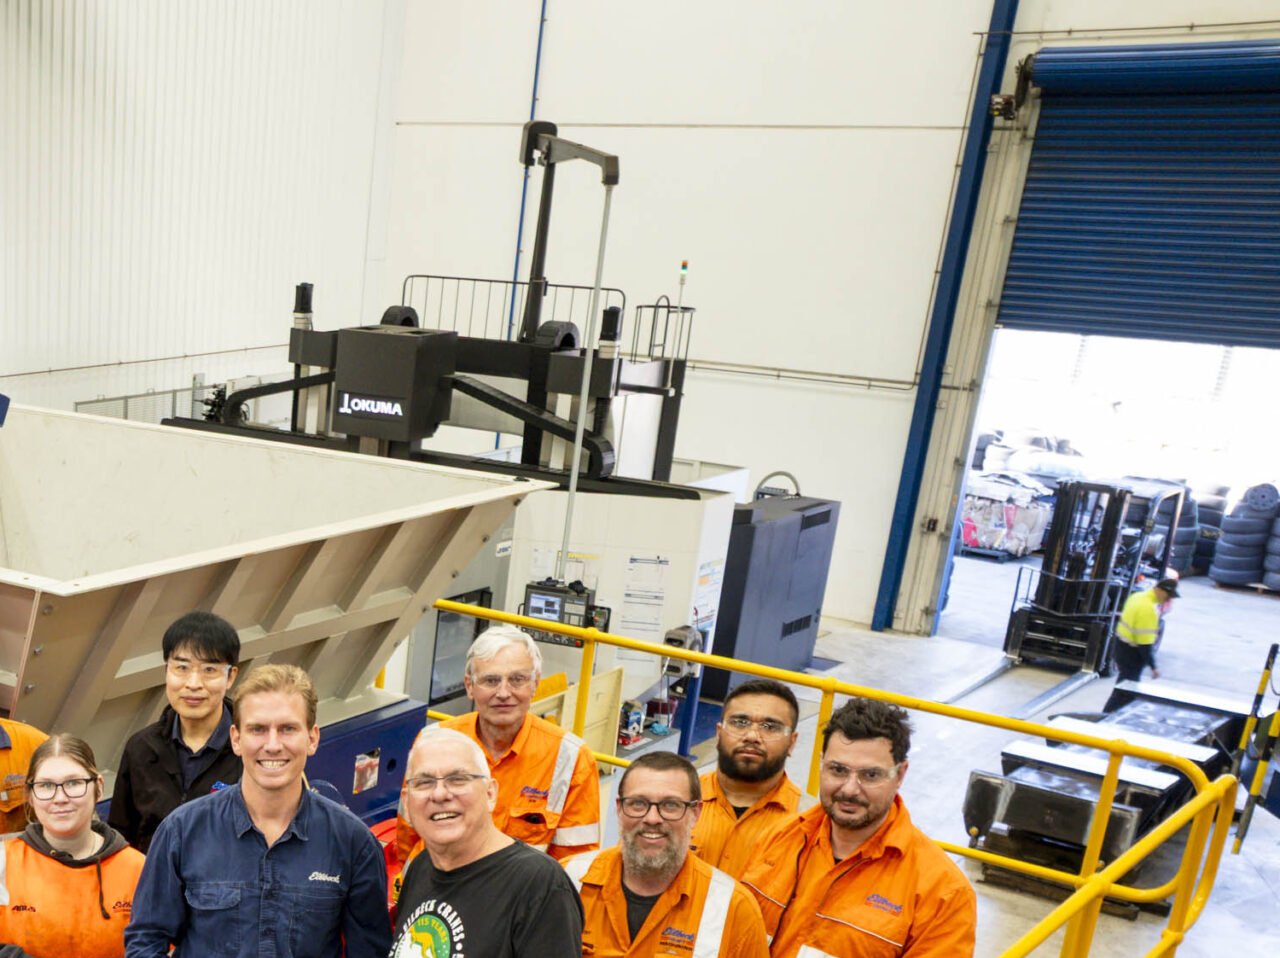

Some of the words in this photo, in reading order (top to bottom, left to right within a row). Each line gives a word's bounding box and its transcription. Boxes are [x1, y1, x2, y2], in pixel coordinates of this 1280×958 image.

[350, 398, 403, 416] OKUMA
[308, 871, 341, 884] Eilbeck
[437, 902, 465, 942] CRANES
